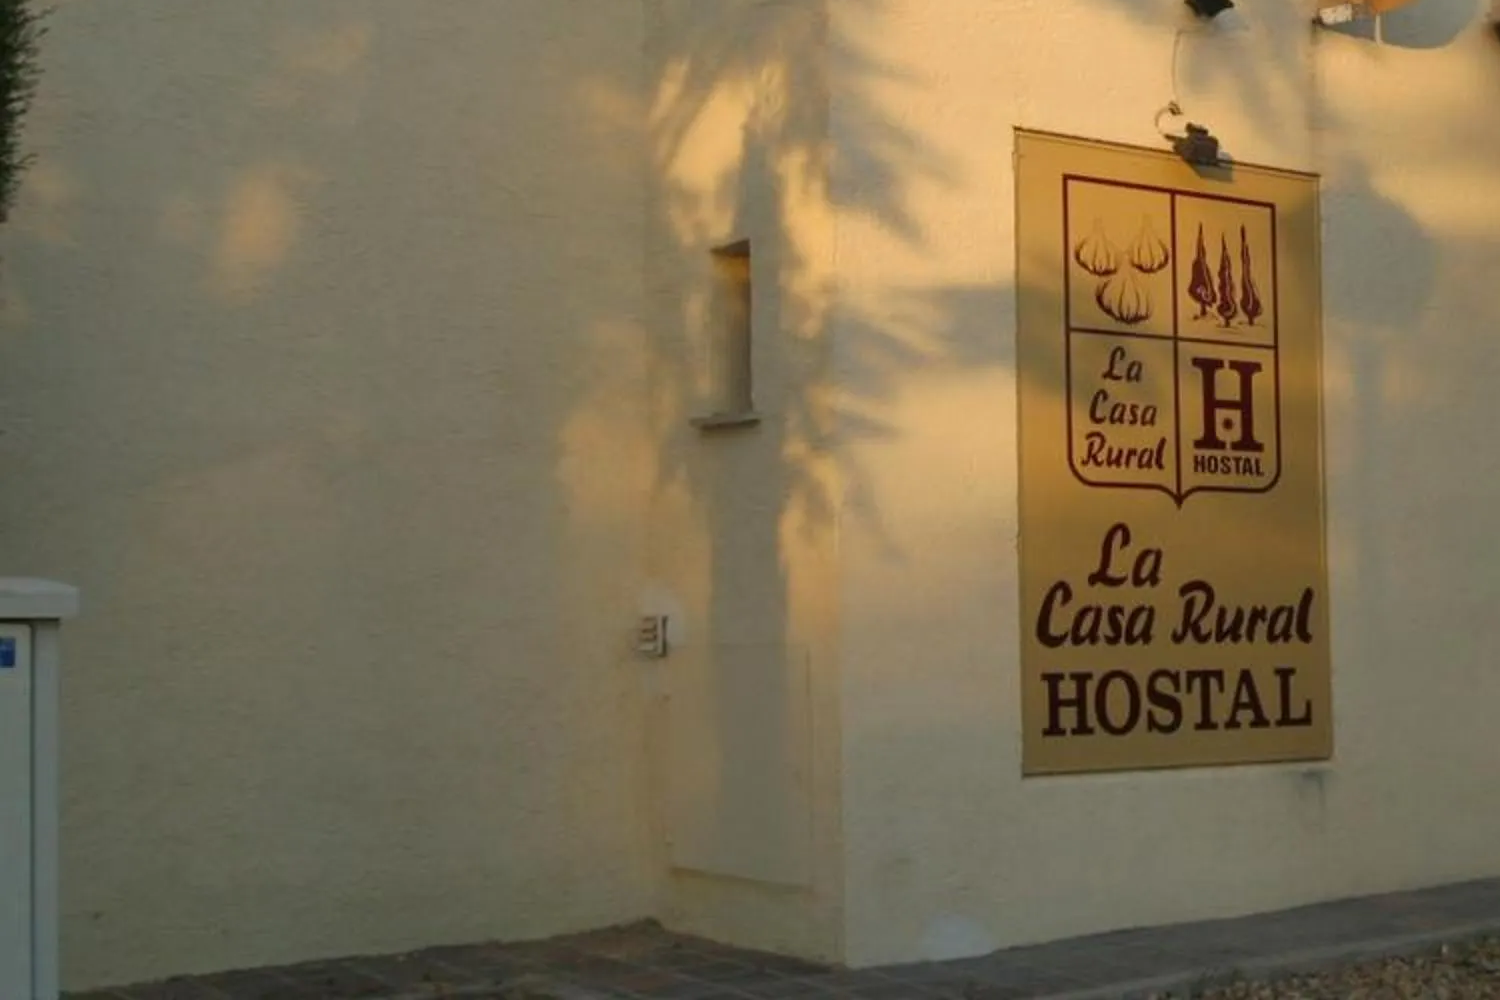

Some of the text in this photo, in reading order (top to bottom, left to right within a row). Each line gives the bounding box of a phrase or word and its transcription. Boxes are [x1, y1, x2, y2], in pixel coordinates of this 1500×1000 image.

[1102, 346, 1143, 382] La
[1088, 388, 1157, 427] Casa
[1080, 431, 1167, 471] Rural
[1192, 454, 1265, 477] HOSTAL
[1087, 521, 1164, 588] La
[1036, 579, 1315, 648] Casa Rural
[1041, 667, 1313, 737] HOSTAL
